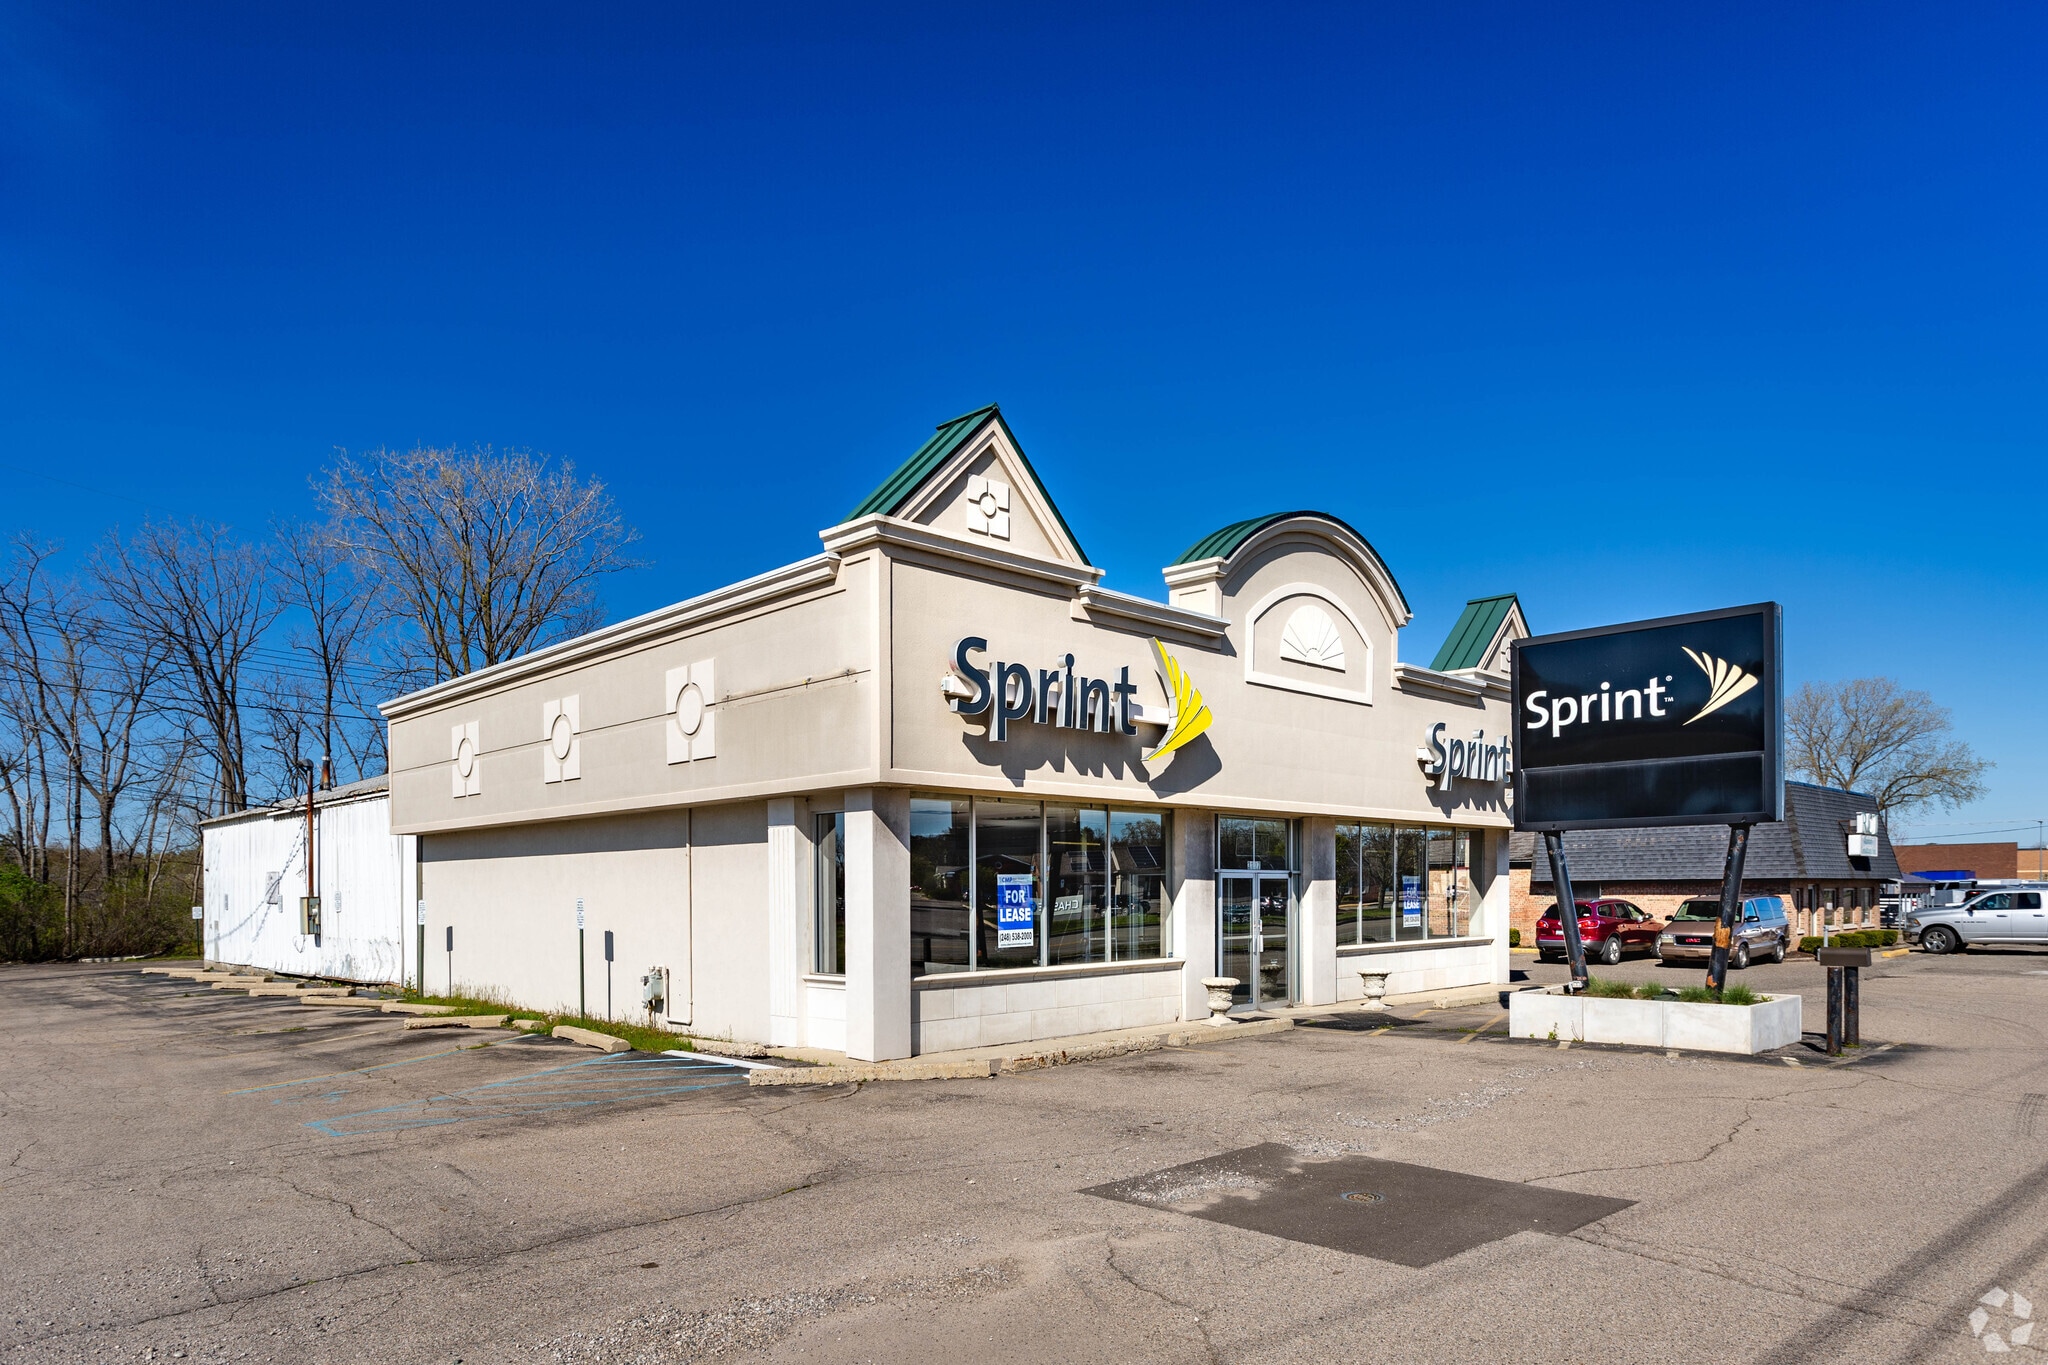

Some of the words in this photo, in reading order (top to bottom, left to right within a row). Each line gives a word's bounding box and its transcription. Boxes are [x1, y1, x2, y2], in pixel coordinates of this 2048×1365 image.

[949, 636, 1138, 742] Sprint
[1525, 676, 1666, 738] Sprint
[1425, 722, 1511, 792] Sprint
[1000, 908, 1031, 922] LEASE
[1005, 889, 1026, 904] FOR
[1403, 901, 1420, 909] LEASE
